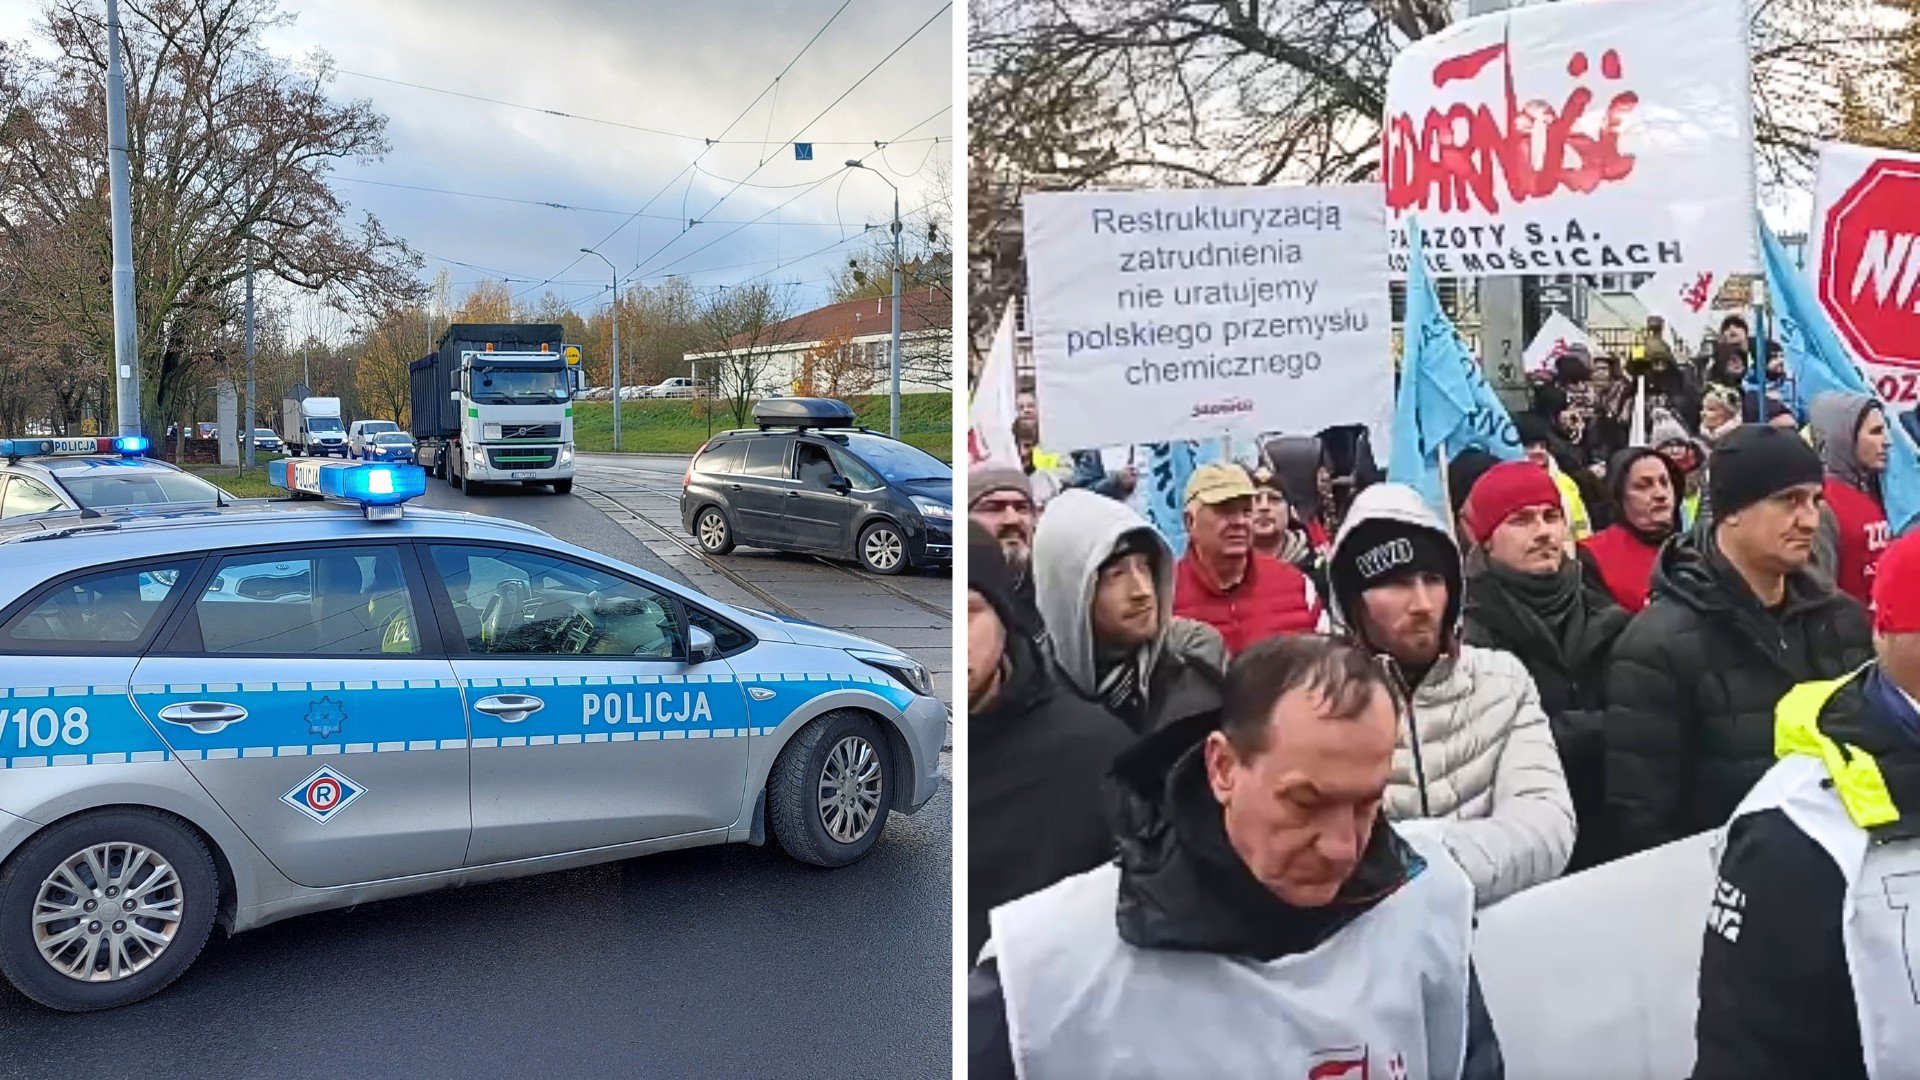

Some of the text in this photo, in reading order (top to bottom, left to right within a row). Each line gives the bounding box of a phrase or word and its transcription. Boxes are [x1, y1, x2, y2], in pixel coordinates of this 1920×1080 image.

[1091, 201, 1342, 236] Restrukturyzacją
[1524, 218, 1602, 246] S.A.
[1119, 239, 1303, 273] zatrudnienia
[1462, 240, 1684, 273] MOŚCICACH
[1117, 277, 1319, 310] nie uratujemy
[1067, 306, 1370, 356] polskiego przemysłu
[1125, 350, 1322, 386] chemicznego
[54, 440, 97, 453] POLICJA
[582, 691, 713, 726] POLICJA
[316, 784, 332, 804] R
